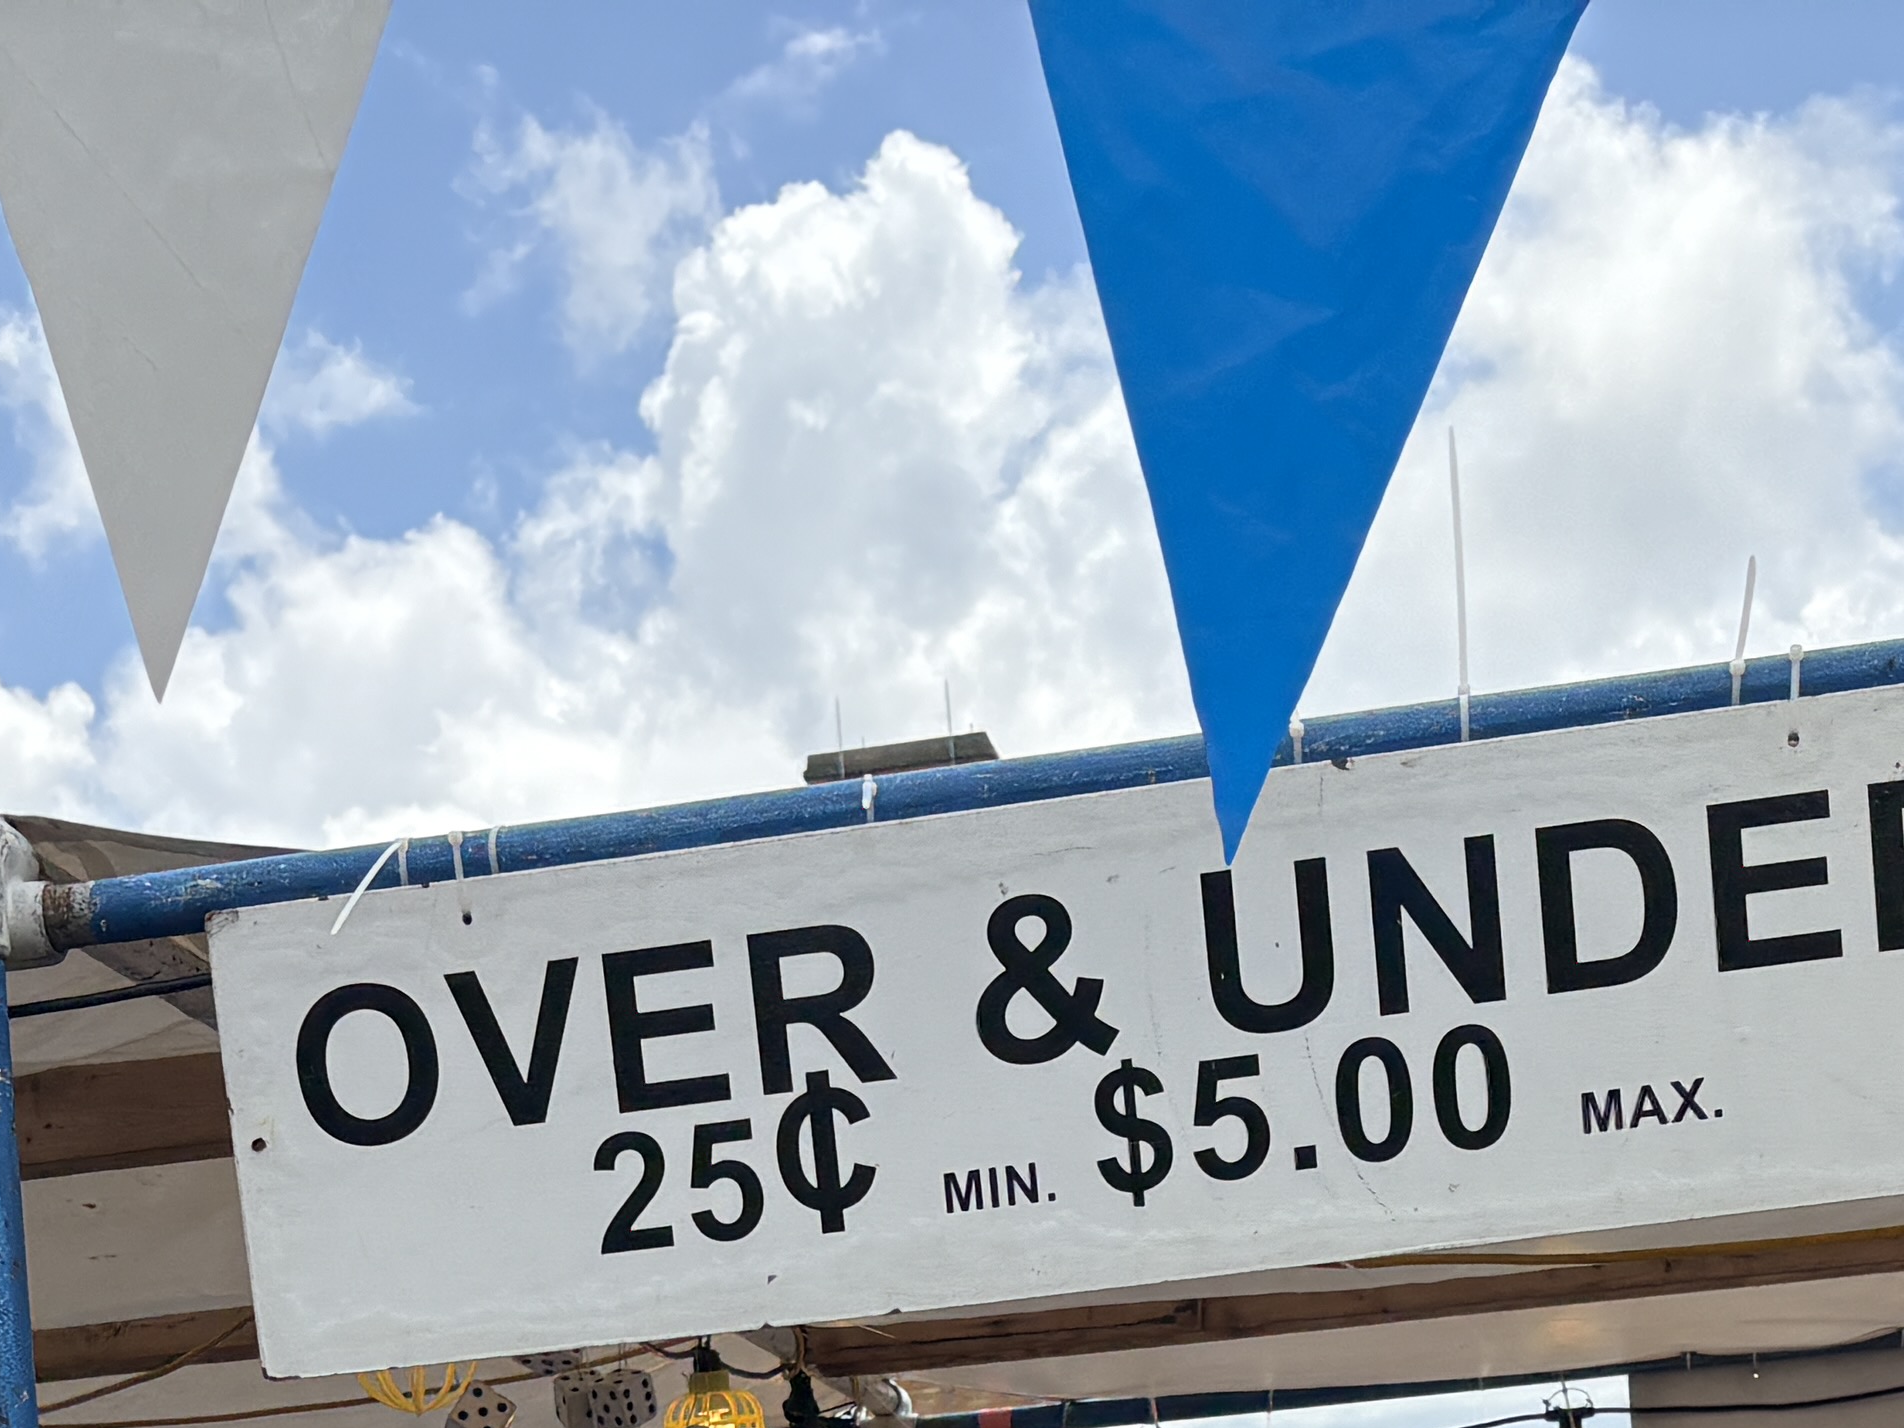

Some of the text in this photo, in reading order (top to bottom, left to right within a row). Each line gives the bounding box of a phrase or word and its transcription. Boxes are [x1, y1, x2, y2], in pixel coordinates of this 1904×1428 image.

[296, 924, 897, 1146] OVER
[975, 893, 1120, 1066] &
[593, 1023, 1725, 1254] 25¢ MIN. $5.00 MAX.
